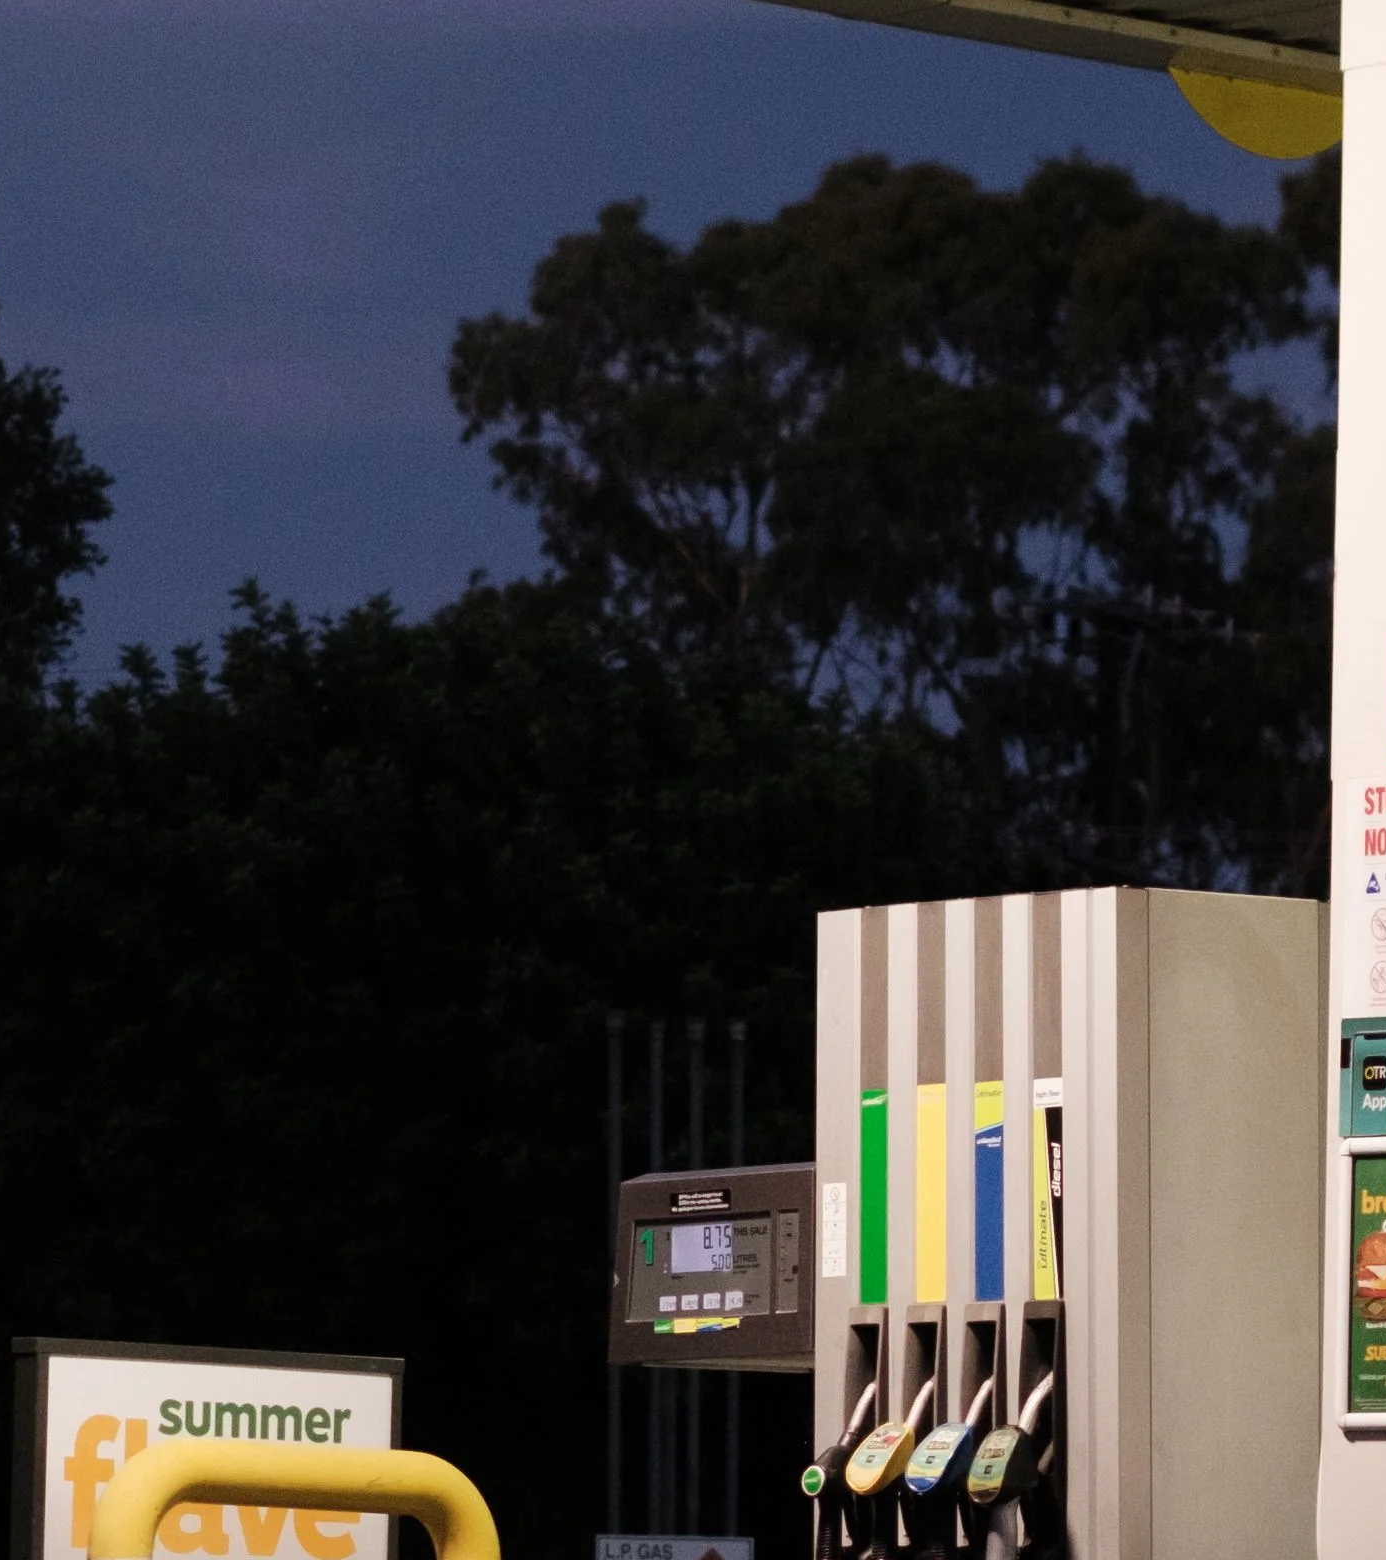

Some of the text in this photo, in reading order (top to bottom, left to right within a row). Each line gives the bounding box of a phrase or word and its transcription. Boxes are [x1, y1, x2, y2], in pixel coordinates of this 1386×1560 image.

[1364, 1065, 1386, 1080] OTR
[1050, 1142, 1062, 1197] diesel
[639, 1228, 655, 1266] 1
[158, 1398, 352, 1444] summer
[638, 1543, 674, 1560] GAS
